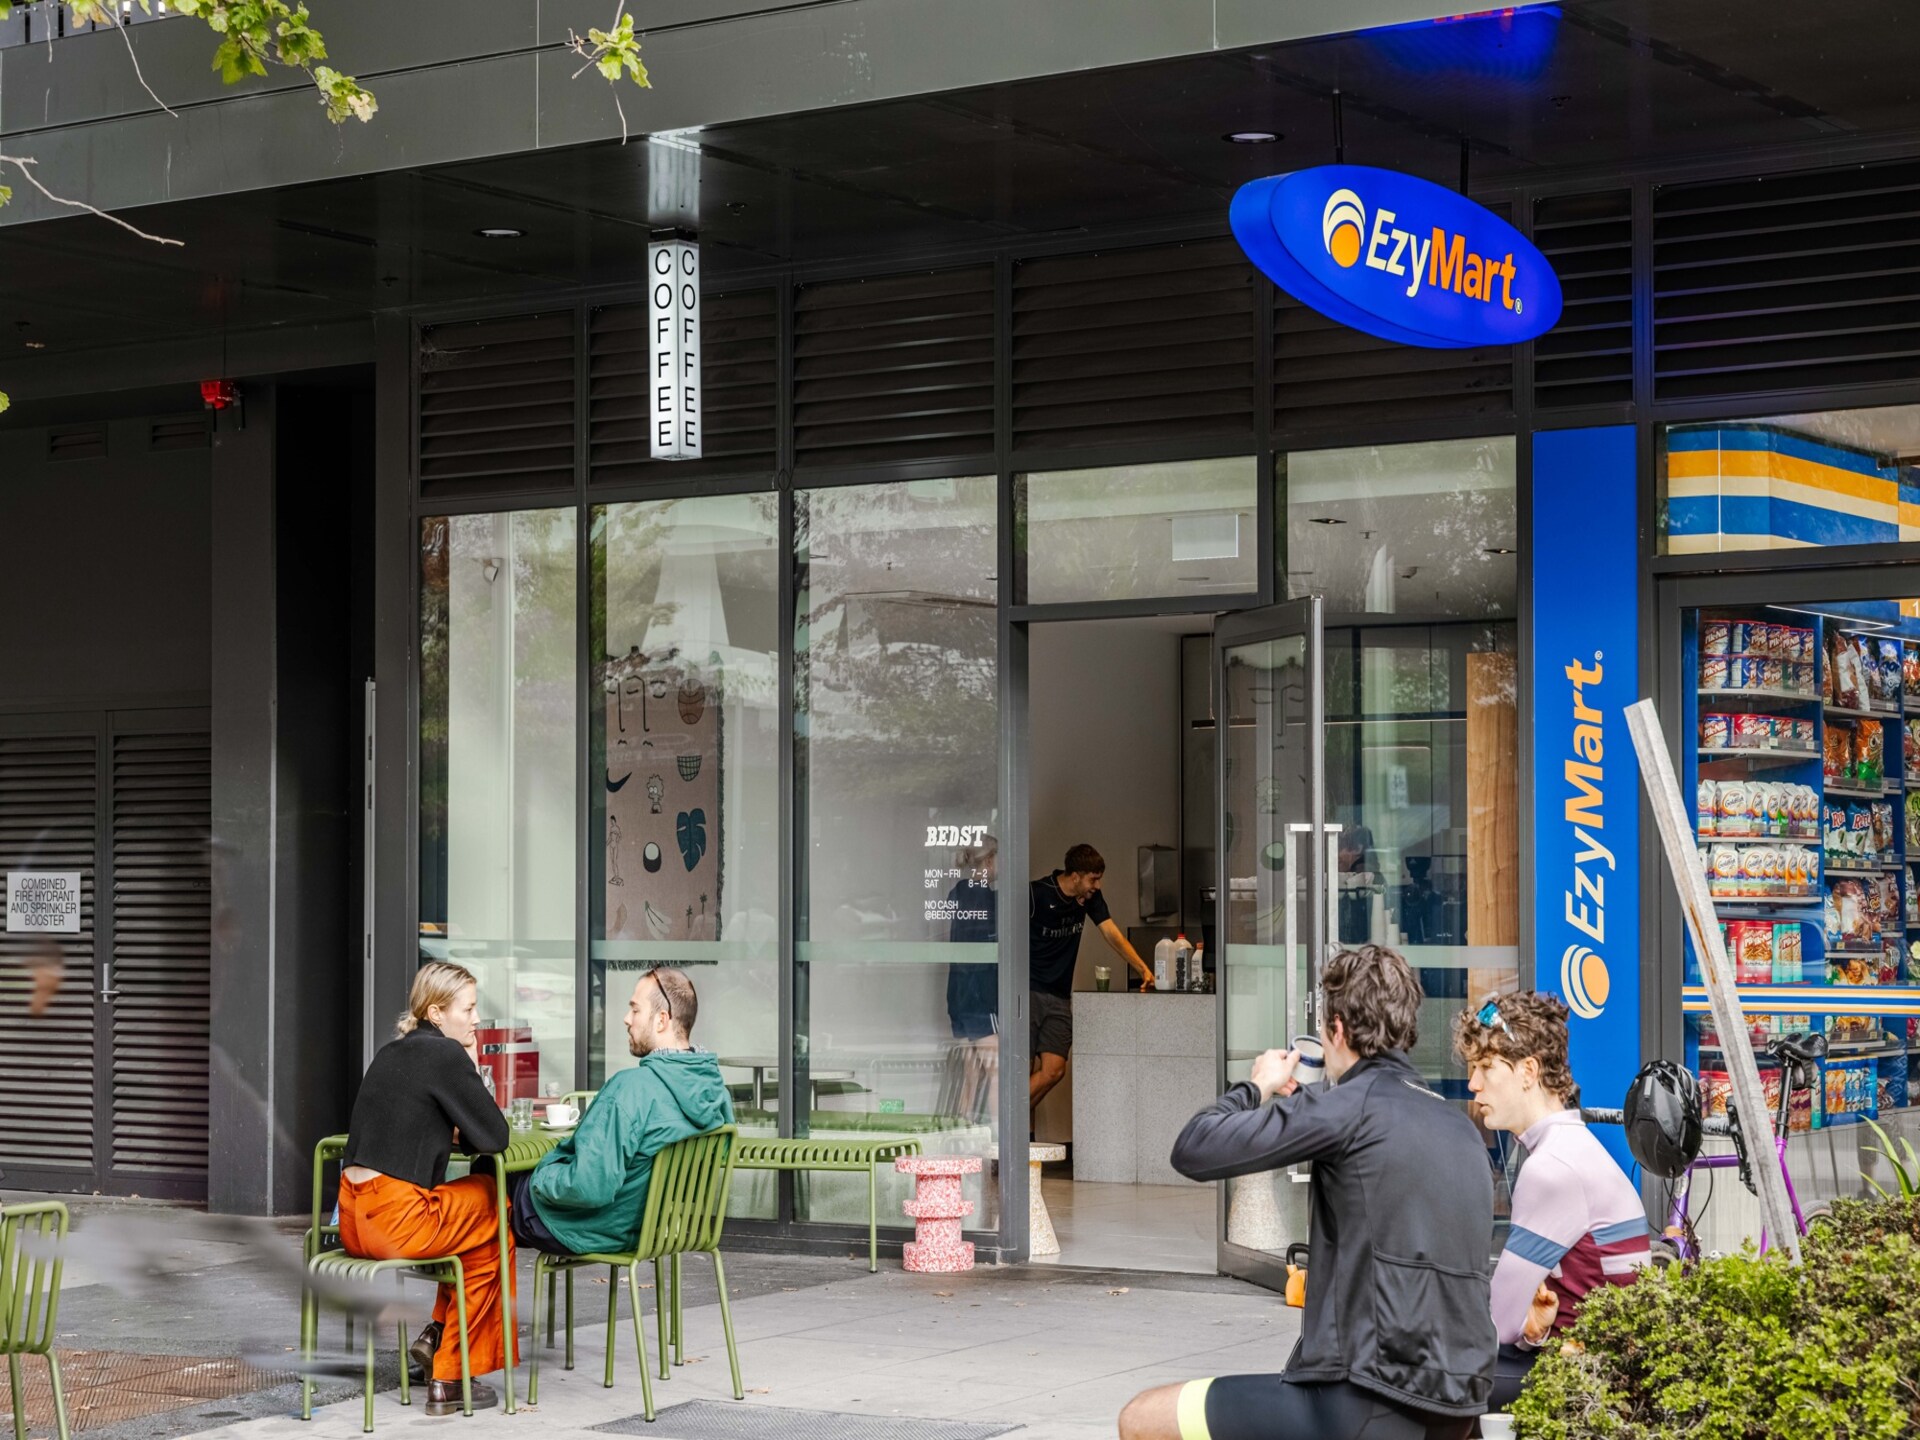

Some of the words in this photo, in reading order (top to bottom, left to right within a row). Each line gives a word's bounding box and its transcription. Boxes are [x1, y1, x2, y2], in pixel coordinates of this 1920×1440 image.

[655, 249, 672, 447] COFFEE
[682, 250, 696, 447] COFFEE
[924, 825, 988, 847] BEDST
[21, 878, 67, 890] COMBINED
[924, 879, 939, 888] SAT
[15, 890, 33, 902] FIRE
[35, 890, 75, 902] HYDRANT
[11, 902, 28, 914] AND
[30, 902, 77, 914] SPRINKLER
[924, 900, 936, 909] NO
[937, 900, 959, 909] CASH
[25, 914, 65, 926] BOOSTER
[924, 910, 956, 920] @BEDST
[956, 910, 988, 920] COFFEE
